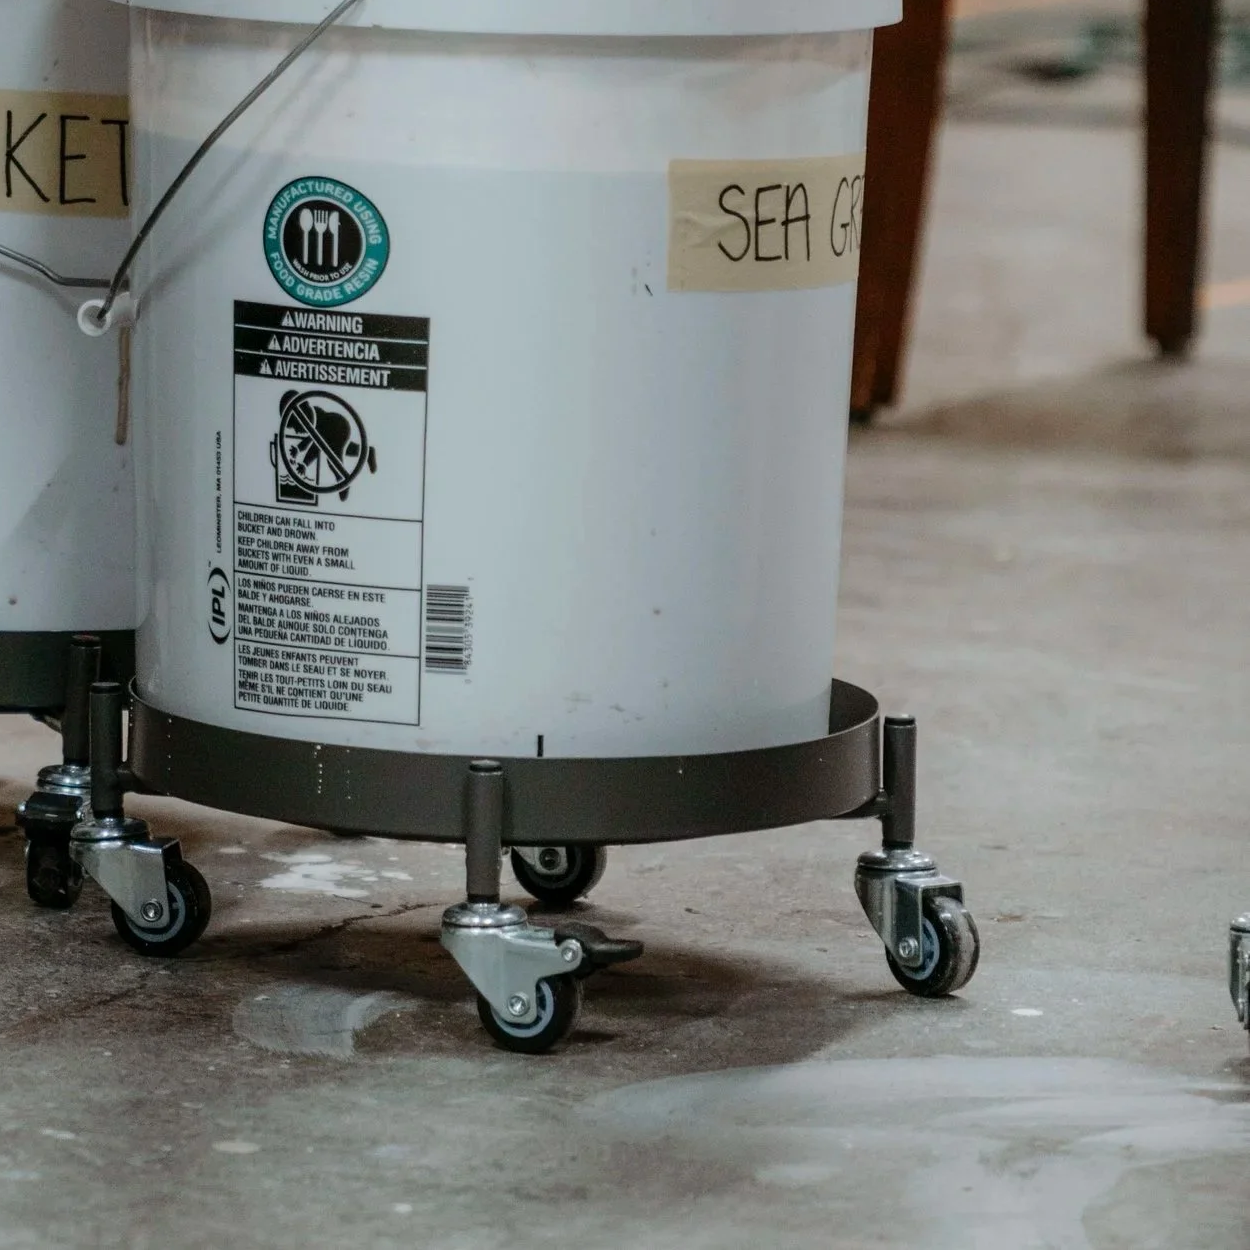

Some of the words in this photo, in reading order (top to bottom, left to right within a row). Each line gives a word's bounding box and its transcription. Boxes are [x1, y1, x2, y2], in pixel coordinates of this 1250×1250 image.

[5, 109, 129, 206] KET
[268, 181, 354, 239] MANUFACTURED
[353, 201, 382, 245] USING
[717, 182, 811, 262] SEA
[270, 251, 295, 288] FOOD
[296, 284, 344, 301] GRADE
[343, 257, 379, 295] RESIN
[292, 257, 310, 277] WASH
[309, 272, 330, 282] PRIOR
[330, 272, 340, 280] TO
[340, 261, 353, 276] USE
[294, 311, 363, 334] WARNING
[282, 336, 380, 361] ADVERTENCIA
[274, 359, 391, 387] AVERTISSEMENT
[215, 477, 222, 491] MA
[237, 510, 274, 522] CHILDREN
[275, 515, 291, 526] CAN
[293, 518, 312, 529] FALL
[314, 521, 335, 531] INTO
[237, 522, 265, 535] BUCKET
[266, 526, 283, 537] AND
[237, 535, 255, 547] KEEP
[256, 538, 294, 552] CHILDREN
[296, 543, 320, 554] AWAY
[322, 547, 350, 558] FROM
[237, 547, 270, 560] BUCKETS
[271, 552, 291, 562] WITH
[293, 554, 315, 565] EVEN
[316, 557, 323, 566] A
[324, 558, 356, 570] SMALL
[237, 558, 268, 571] AMOUNT
[270, 563, 280, 573] OF
[282, 565, 312, 577] LIQUID.
[237, 577, 252, 588] LOS
[253, 578, 276, 592] NIÑOS
[277, 583, 310, 595] PUEDEN
[311, 586, 346, 599] CAERSE
[347, 590, 360, 600] EN
[362, 592, 386, 603] ESTE
[237, 589, 260, 601] BALDE
[262, 593, 267, 601] Y
[268, 594, 314, 608] AHOGARSE.
[237, 602, 278, 617] MANTENGA
[279, 608, 285, 618] A
[286, 609, 302, 620] LOS
[304, 609, 331, 623] NIÑOS
[332, 614, 380, 628] ALEJADOS
[237, 614, 252, 625] DEL
[252, 616, 276, 628] BALDE
[277, 619, 310, 632] AUNQUE
[312, 623, 336, 635] SOLO
[337, 626, 389, 639] CONTENGA
[238, 625, 253, 636] UNA
[254, 626, 289, 641] PEQUEÑA
[290, 632, 332, 646] CANTIDAD
[334, 637, 346, 647] DE
[238, 644, 251, 655] LES
[252, 646, 280, 659] JEUNES
[281, 650, 318, 663] ENFANTS
[319, 654, 359, 666] PEUVENT
[238, 655, 268, 668] TOMBER
[269, 660, 290, 672] DANS
[291, 663, 300, 673] LE
[302, 664, 325, 675] SEAU
[327, 667, 337, 676] ET
[340, 667, 351, 677] SE
[353, 669, 390, 681] NOYER.
[238, 669, 259, 680] TENIR
[260, 672, 274, 683] LES
[275, 674, 326, 688] TOUT-PETITS
[327, 679, 348, 690] LOIN
[350, 681, 365, 692] DU
[367, 683, 393, 694] SEAU
[238, 679, 259, 692] MÊME
[276, 686, 285, 696] NE
[287, 686, 327, 699] CONTIENT
[238, 691, 261, 703] PETITE
[301, 699, 311, 709] DE
